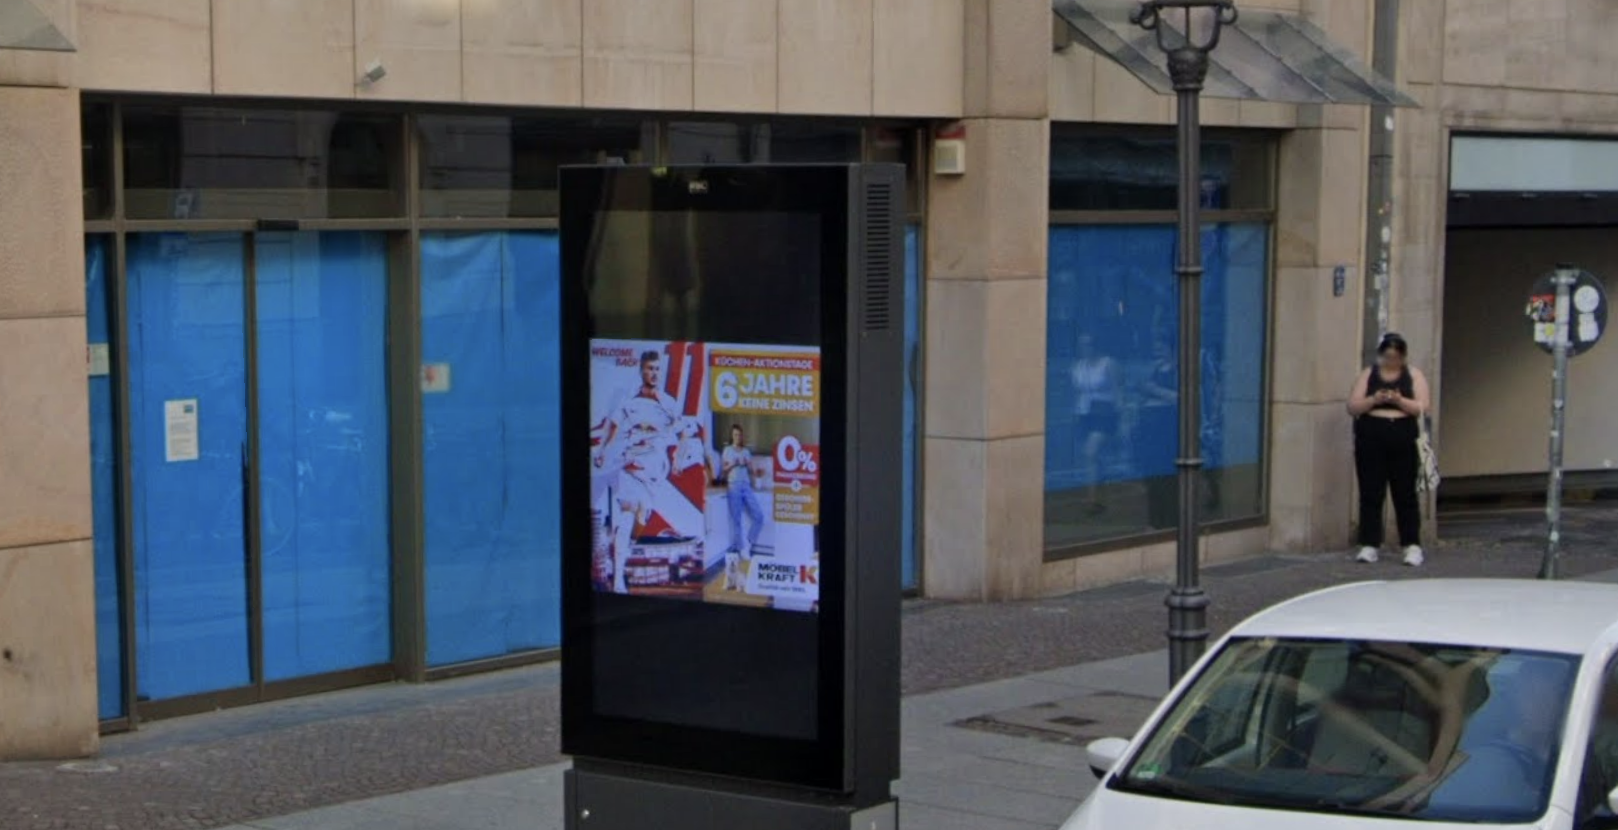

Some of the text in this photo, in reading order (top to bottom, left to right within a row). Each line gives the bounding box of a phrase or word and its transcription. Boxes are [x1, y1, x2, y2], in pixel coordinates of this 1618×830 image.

[664, 341, 705, 416] 11
[716, 371, 814, 409] 6 JAHRE
[740, 397, 770, 410] KEINE
[777, 435, 817, 473] 0%
[758, 572, 796, 583] KRAFT
